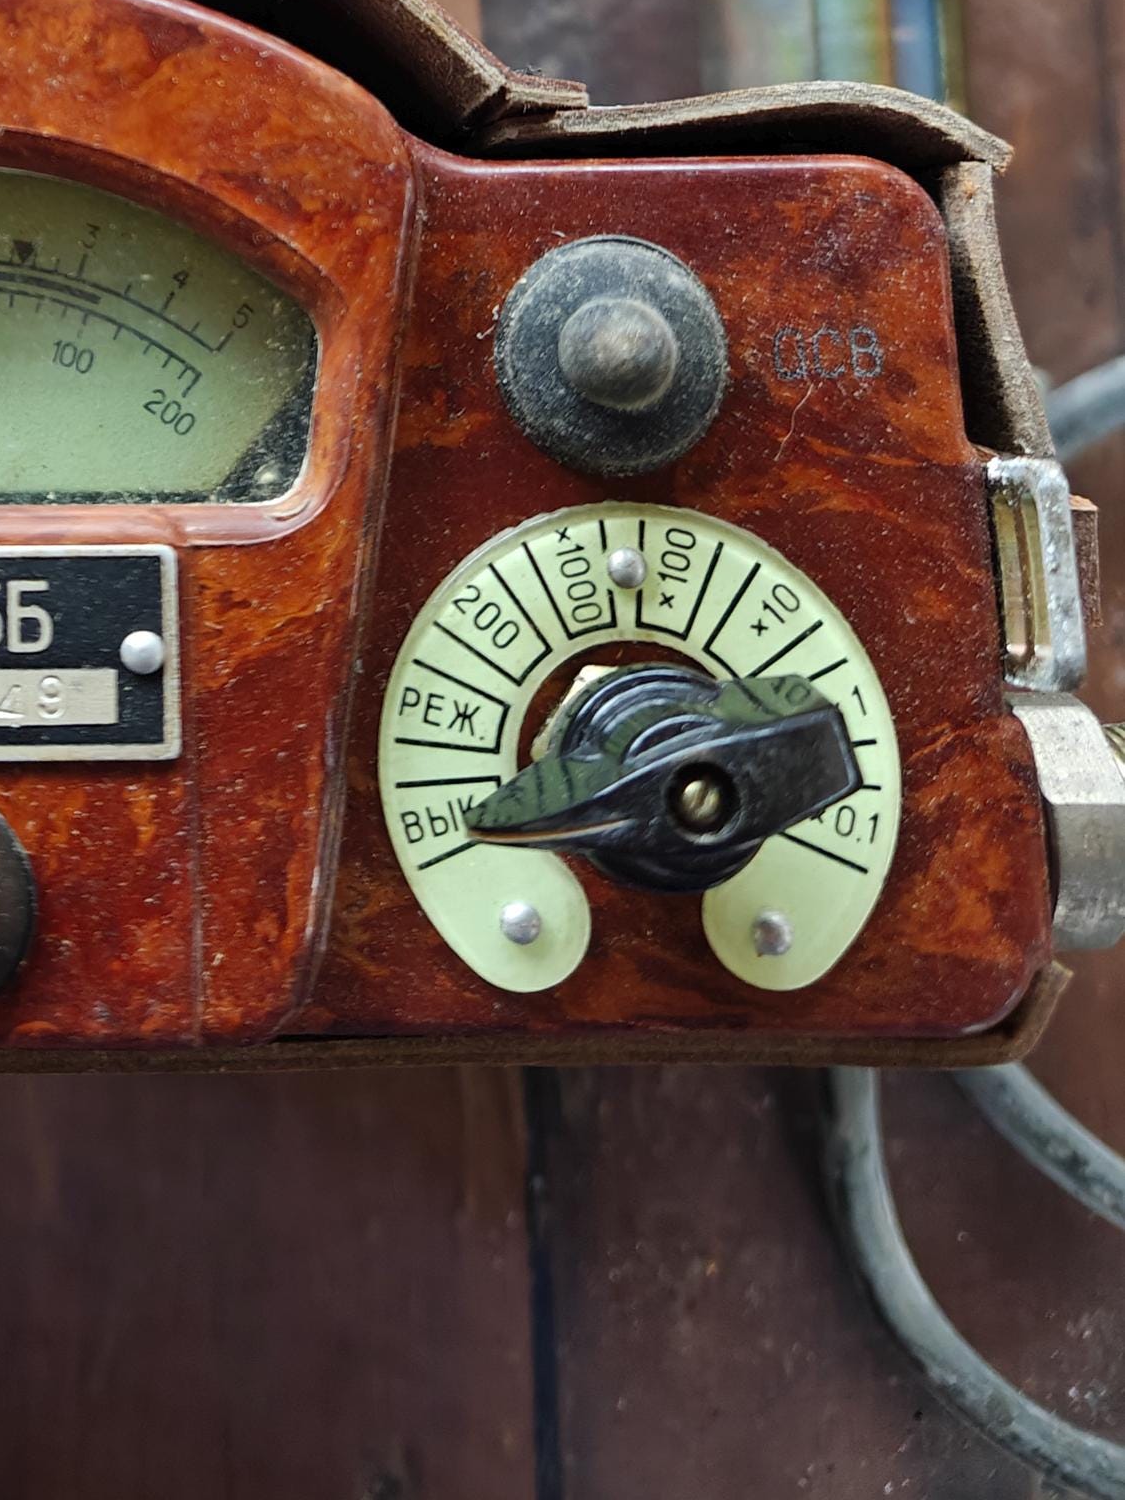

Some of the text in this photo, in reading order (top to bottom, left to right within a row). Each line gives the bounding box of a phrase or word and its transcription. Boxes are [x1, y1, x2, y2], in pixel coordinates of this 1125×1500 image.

[77, 222, 101, 250] 3
[171, 269, 191, 290] 4
[232, 303, 255, 329] 5
[51, 340, 94, 374] 100
[142, 388, 196, 436] 200
[452, 584, 521, 650] 200
[399, 685, 486, 741] РЕЖ.
